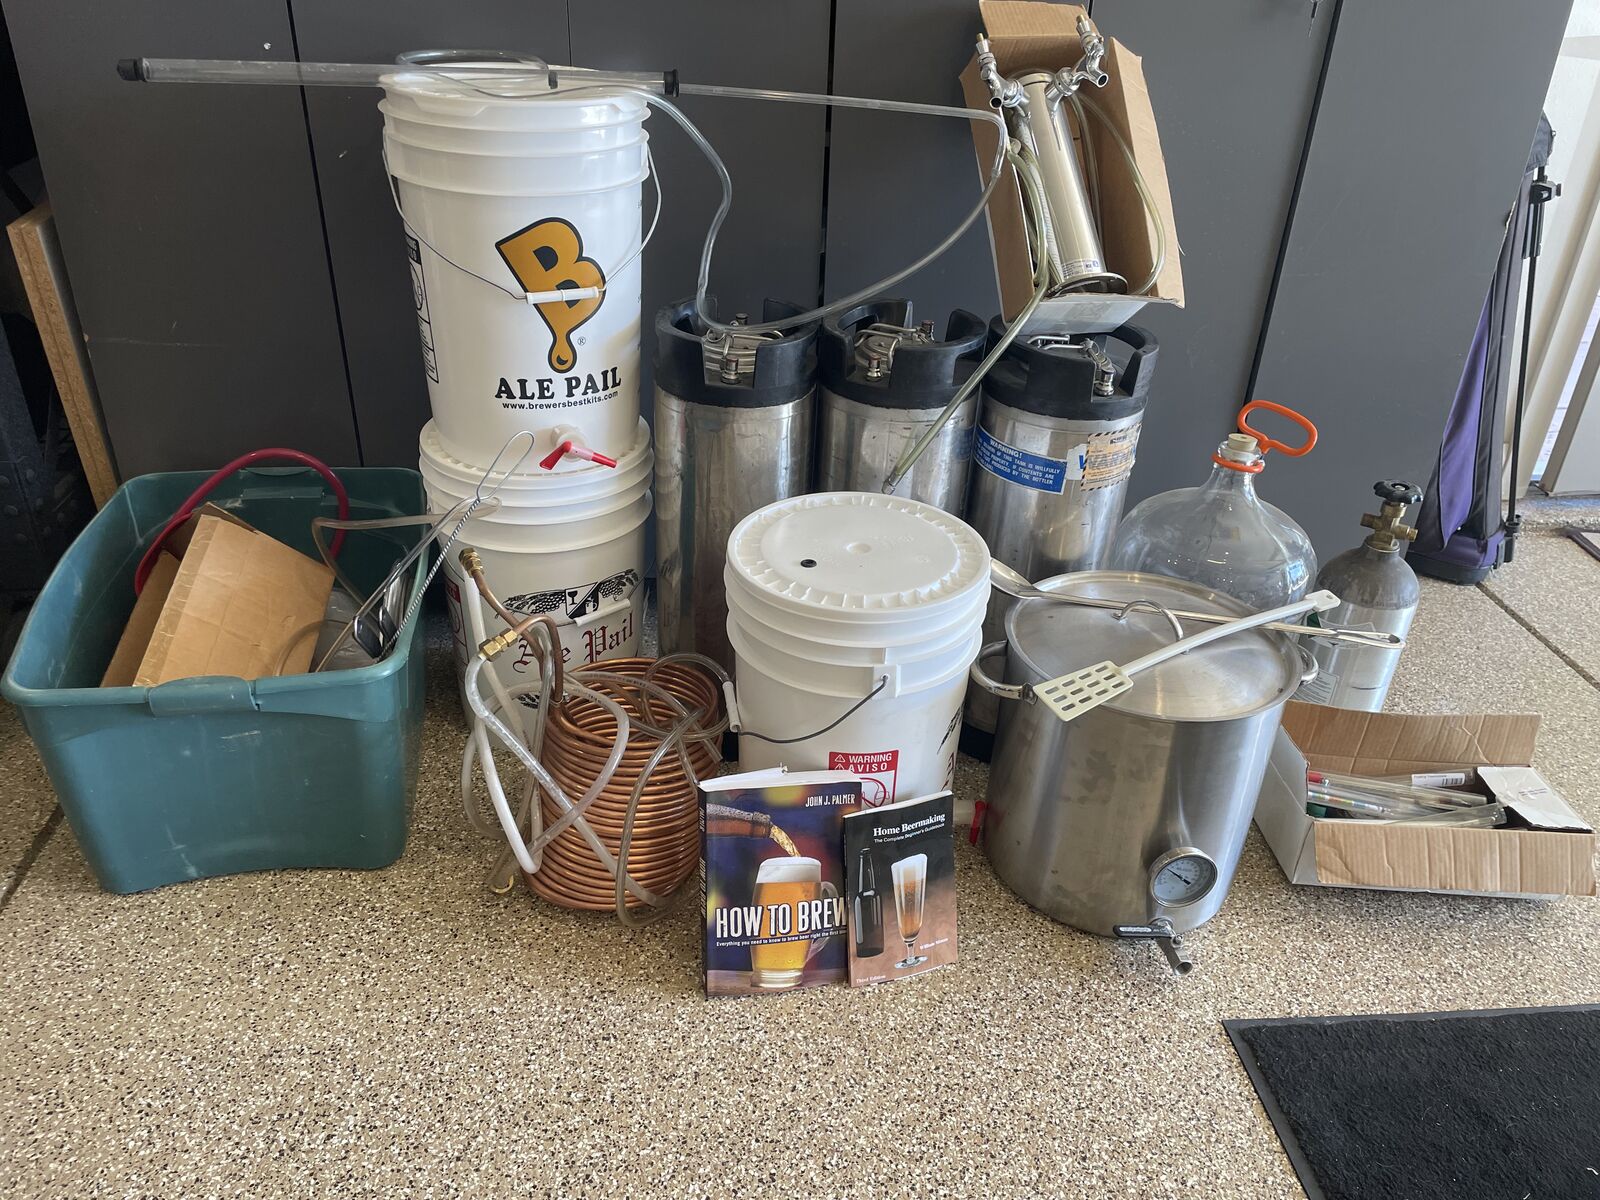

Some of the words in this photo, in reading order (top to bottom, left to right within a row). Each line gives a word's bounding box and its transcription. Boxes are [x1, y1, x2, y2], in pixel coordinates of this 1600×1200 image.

[494, 377, 555, 400] ALE
[564, 366, 622, 398] PAIL
[502, 390, 619, 410] www.brewersbestkits.com
[1034, 464, 1061, 475] WILLFULLY
[1032, 477, 1053, 485] BOTTLER
[849, 752, 892, 764] WARNING
[849, 763, 888, 773] AVISO
[805, 796, 823, 807] JOHN
[823, 795, 831, 806] J.
[832, 793, 856, 805] PALMER
[873, 827, 900, 837] Home
[901, 813, 946, 833] Beermaking
[883, 835, 904, 843] Complete
[715, 906, 762, 939] HOW
[767, 903, 790, 934] TO
[798, 897, 847, 933] BREW
[716, 940, 741, 948] Everything
[810, 932, 821, 940] right
